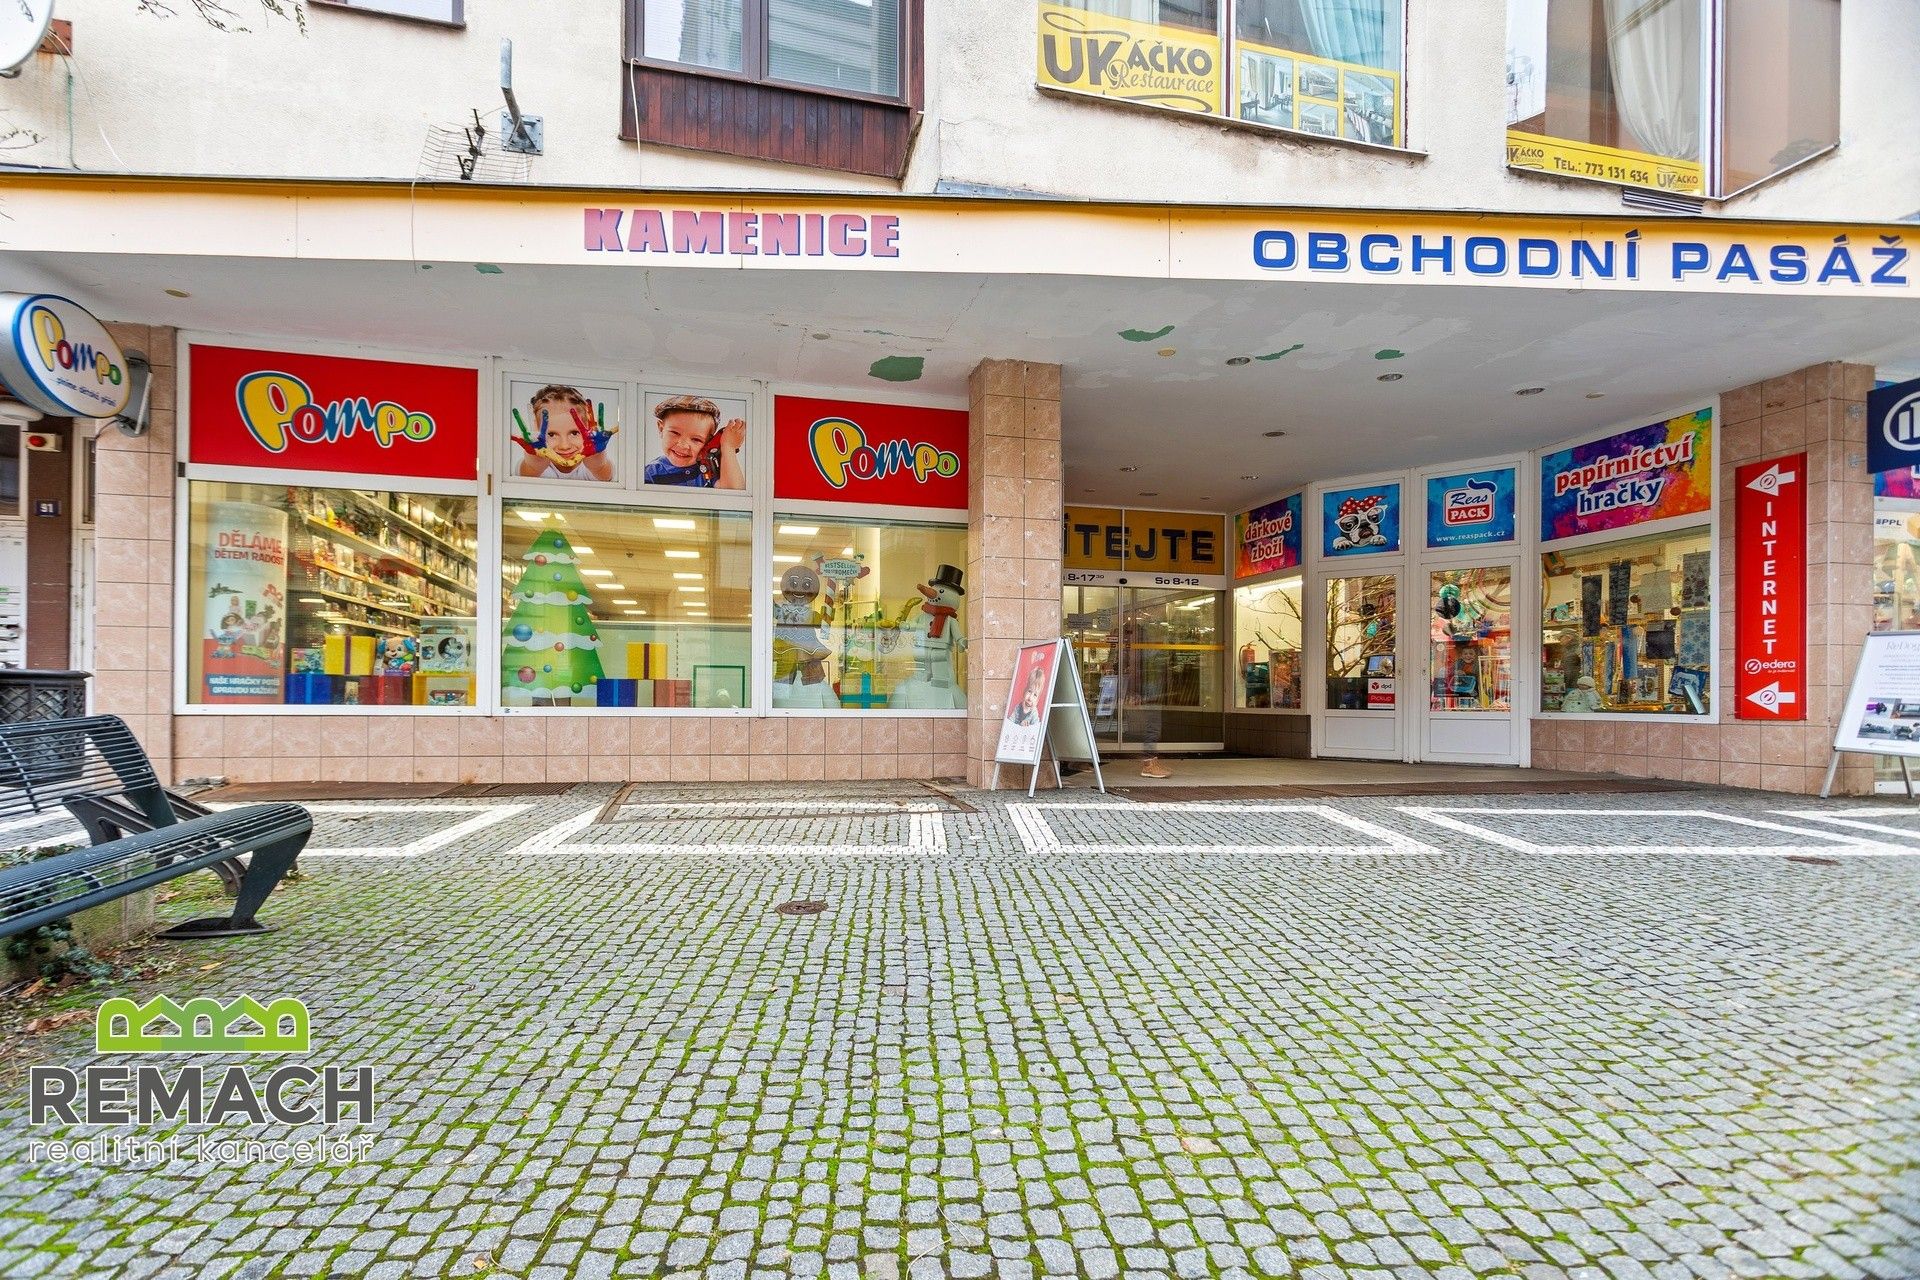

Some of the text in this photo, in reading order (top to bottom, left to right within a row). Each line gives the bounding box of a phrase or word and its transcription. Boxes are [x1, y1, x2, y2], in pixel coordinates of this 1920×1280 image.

[1107, 59, 1214, 93] Restaurace
[1585, 162, 1604, 177] 773
[1608, 166, 1626, 180] 131
[584, 208, 899, 257] KAMENICE
[1253, 229, 1908, 286] OBCHODNÍ PASÁŽ
[30, 306, 122, 385] Pompo
[236, 371, 436, 454] Pompo
[808, 417, 960, 489] Pompo
[1450, 492, 1488, 507] Reas
[1579, 478, 1664, 514] hračky
[1244, 511, 1292, 541] dárkové
[1450, 507, 1487, 520] PACK
[1881, 518, 1903, 527] PPL
[219, 530, 282, 554] DĚLÁME
[1064, 512, 1214, 563] ÍTEJTE
[1251, 535, 1284, 562] zboží
[1436, 531, 1505, 542] www.reaspack.cz
[215, 548, 249, 560] DĚTEM
[1155, 576, 1170, 585] So
[1172, 577, 1199, 586] 8-12
[1762, 501, 1777, 655] INTERNET
[1763, 659, 1796, 669] edera
